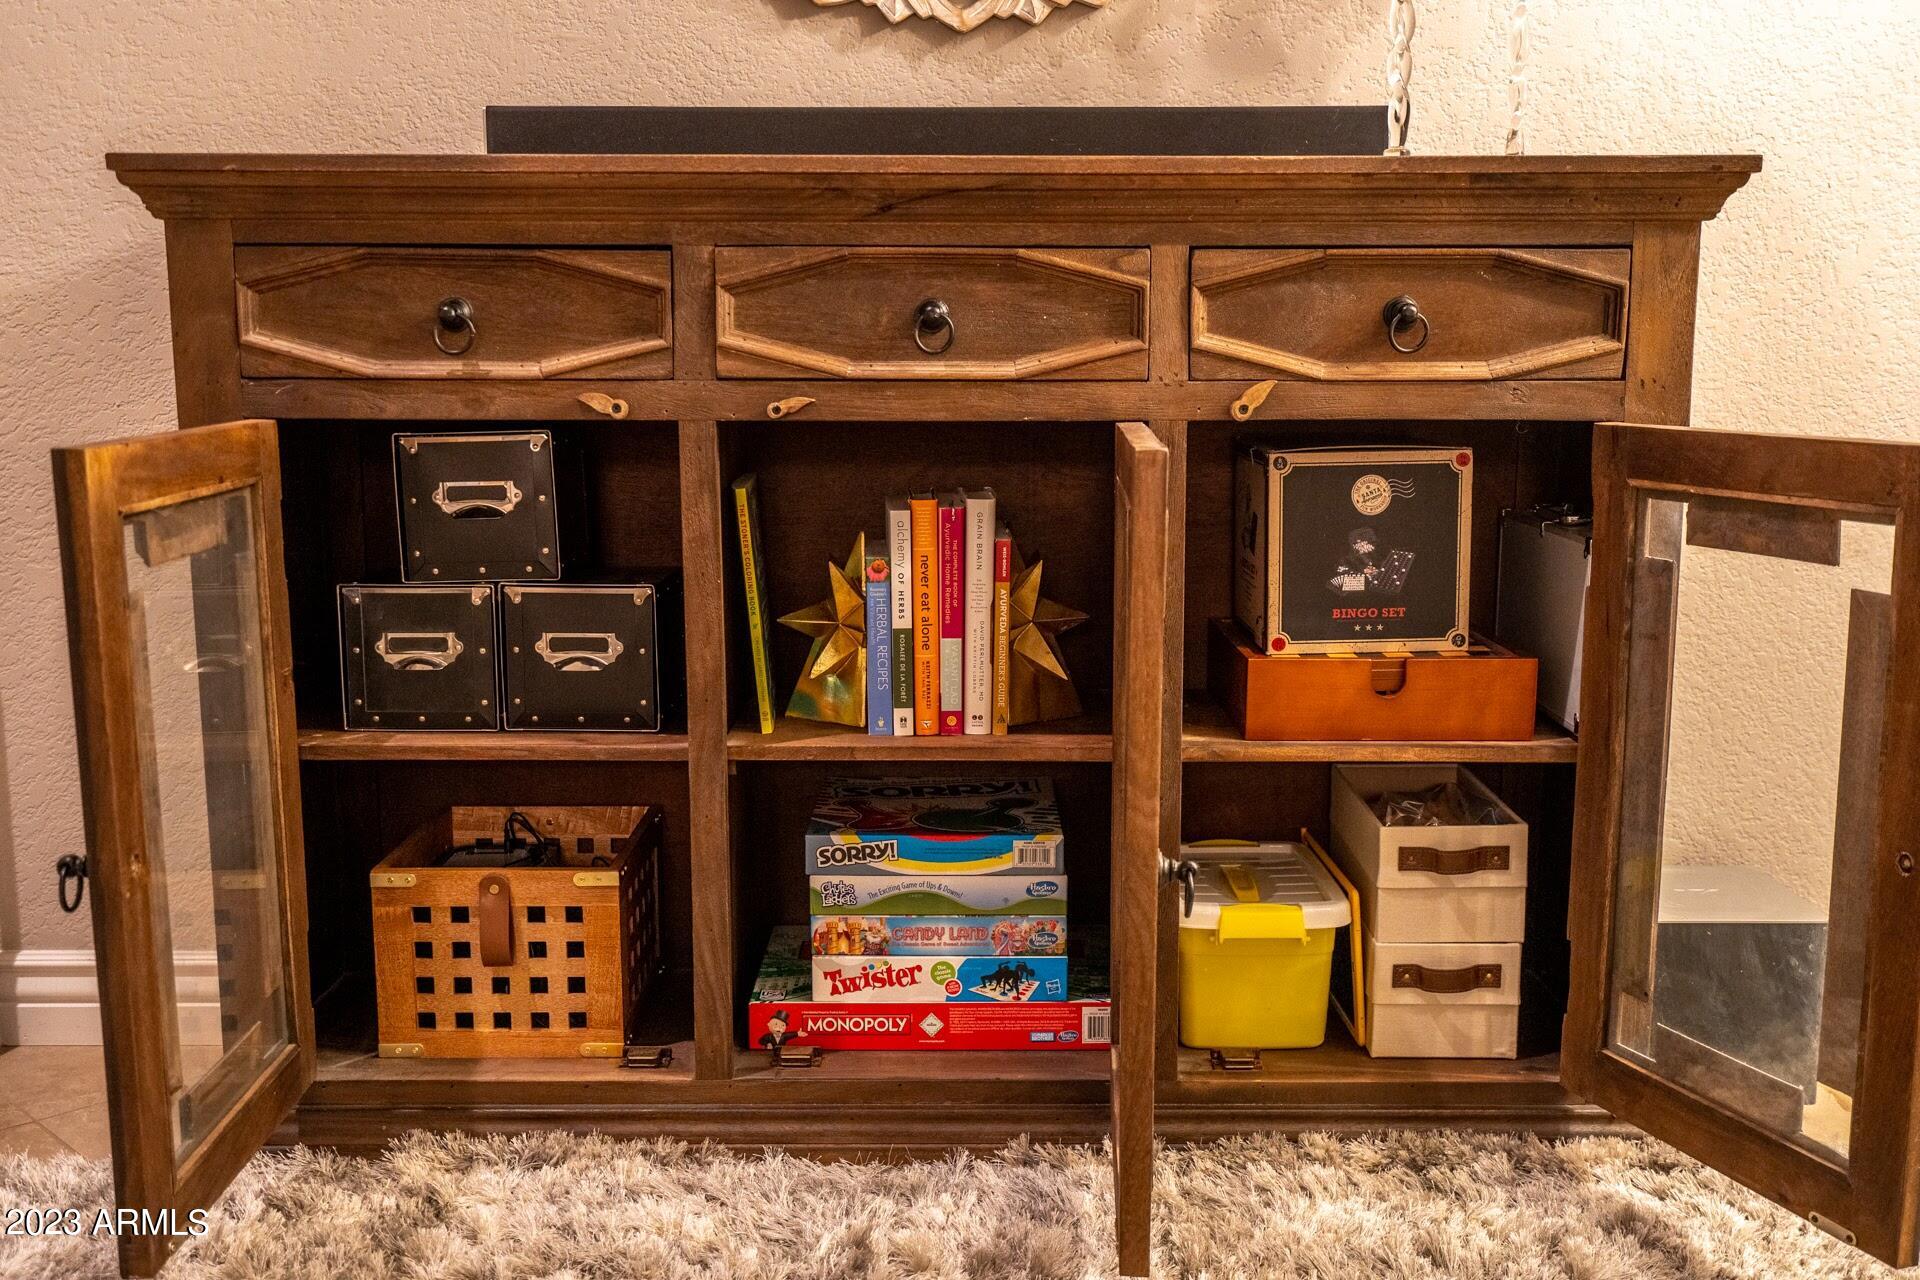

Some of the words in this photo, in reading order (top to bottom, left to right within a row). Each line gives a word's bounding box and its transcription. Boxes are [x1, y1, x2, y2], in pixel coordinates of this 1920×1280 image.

[738, 503, 746, 518] THE
[740, 519, 750, 556] STONER'S
[895, 520, 908, 568] alchemy
[743, 556, 755, 595] COLORING
[897, 572, 904, 585] OF
[920, 554, 929, 589] never
[944, 563, 952, 586] Home
[748, 596, 757, 617] BOOK
[920, 591, 931, 612] eat
[944, 587, 952, 624] Remedies
[953, 599, 958, 608] OF
[999, 588, 1008, 634] AYURVEDA
[876, 598, 888, 642] HERBAL
[1332, 607, 1378, 620] BINGO
[1382, 607, 1406, 617] SET
[921, 616, 933, 651] alone
[877, 645, 889, 690] RECIPES
[900, 663, 906, 672] DE
[950, 644, 958, 682] VASANT
[997, 635, 1007, 682] BEGINNER'S
[900, 674, 907, 682] LA
[950, 686, 958, 705] LAD
[978, 692, 984, 702] MD
[997, 683, 1006, 708] GUIDE
[817, 840, 898, 867] SORRY!
[821, 880, 855, 895] Chutes
[878, 883, 901, 896] Exciting
[901, 881, 918, 890] Game
[926, 881, 937, 890] Ups
[942, 885, 964, 899] Downs!
[1030, 882, 1057, 891] Hasbro
[821, 893, 858, 907] Ladders
[892, 926, 945, 941] CANDY
[949, 926, 989, 941] LAND
[1032, 934, 1057, 942] Hasbro
[823, 962, 922, 996] Twister
[807, 1017, 907, 1032] MONOPOLY
